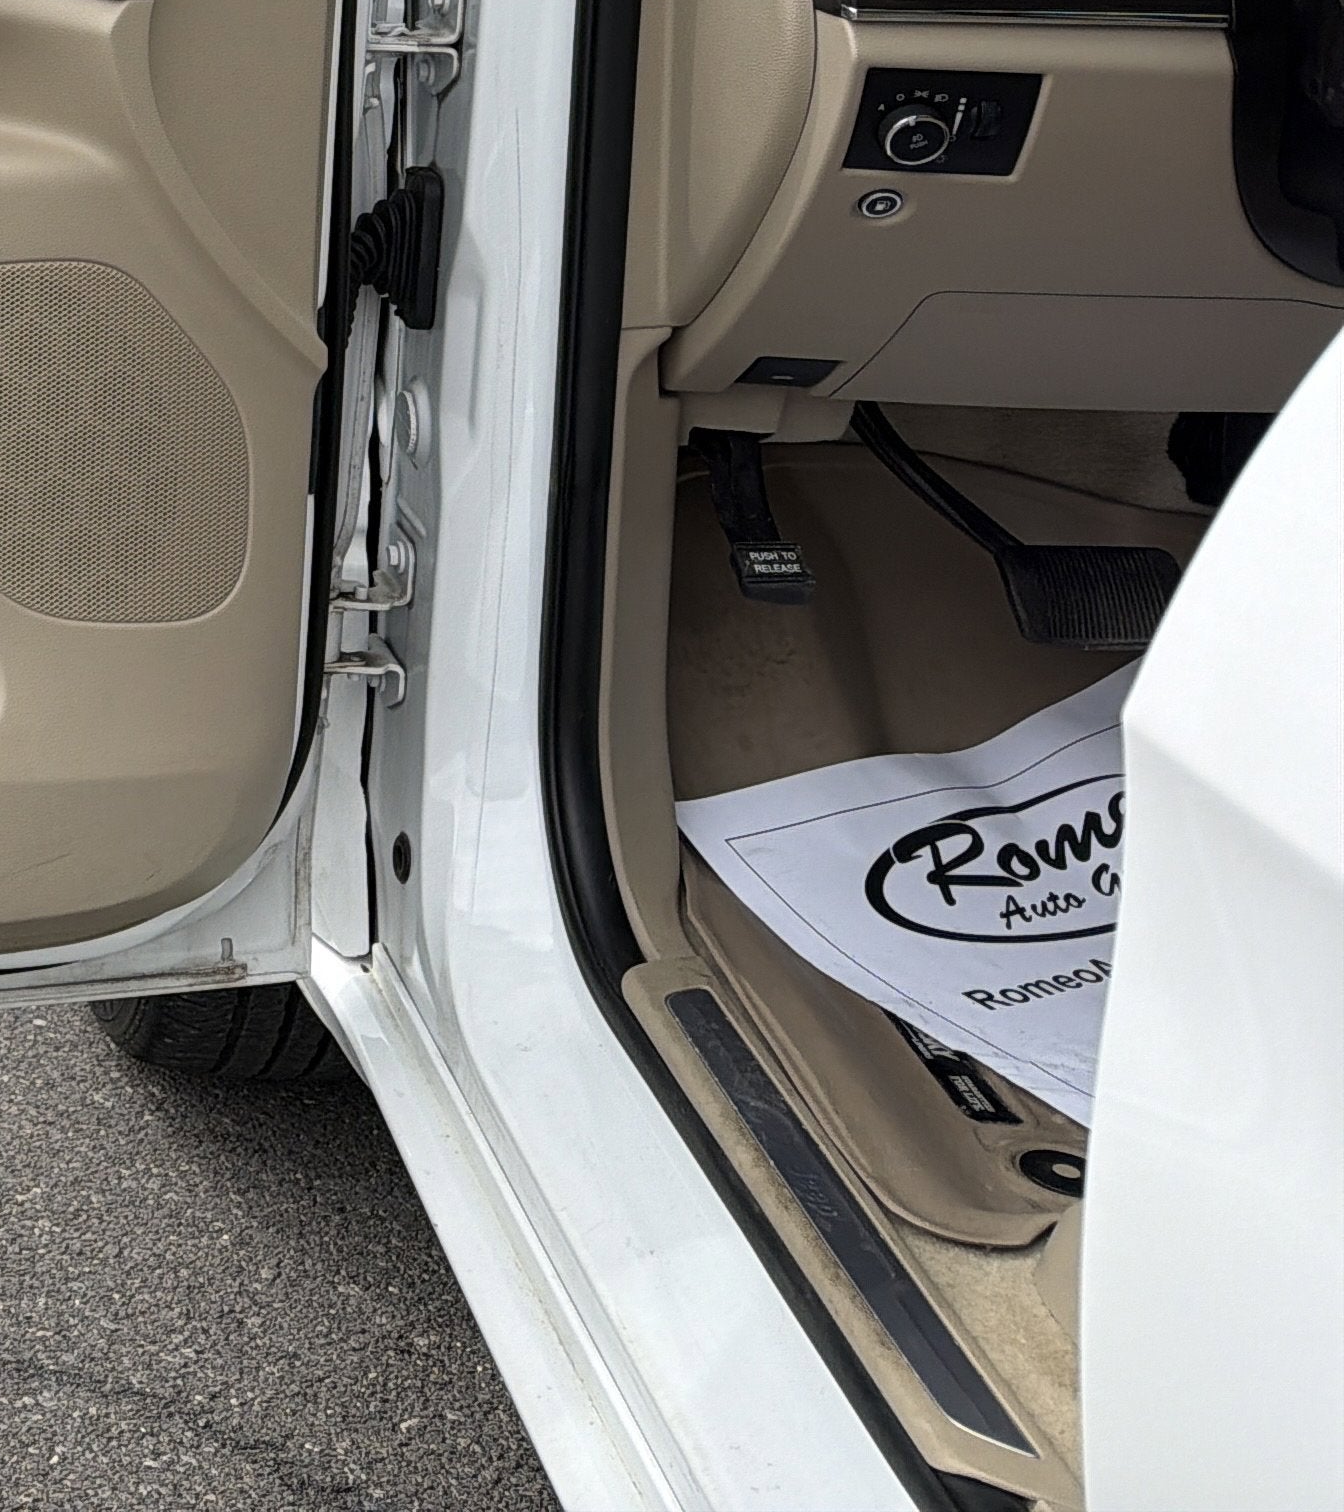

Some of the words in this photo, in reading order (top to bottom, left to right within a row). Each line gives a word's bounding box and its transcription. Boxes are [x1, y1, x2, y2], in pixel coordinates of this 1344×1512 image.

[749, 551, 779, 561] PUSH
[781, 551, 797, 560] TO
[754, 563, 802, 574] RELEASE
[999, 891, 1087, 930] Auto
